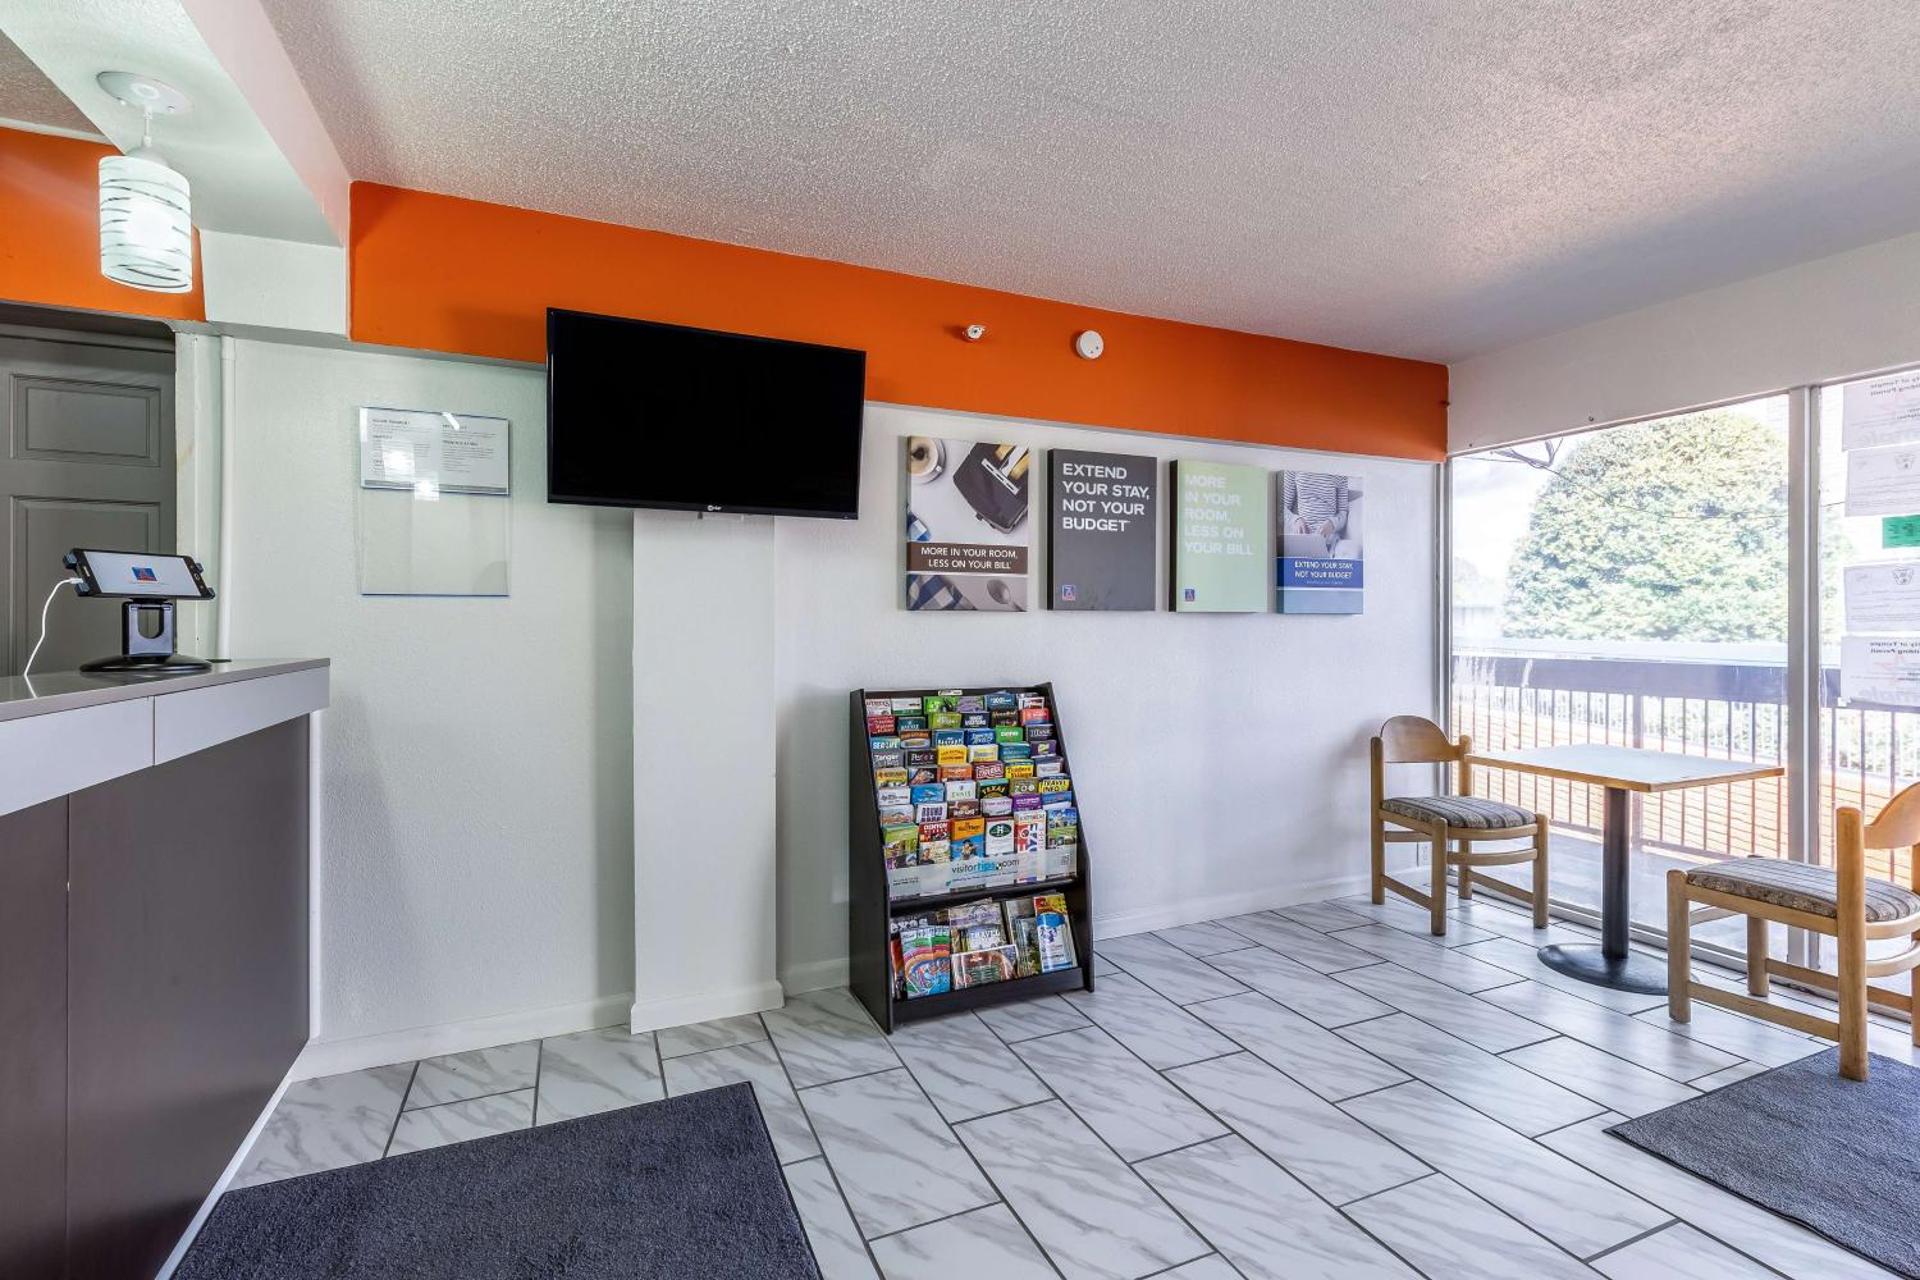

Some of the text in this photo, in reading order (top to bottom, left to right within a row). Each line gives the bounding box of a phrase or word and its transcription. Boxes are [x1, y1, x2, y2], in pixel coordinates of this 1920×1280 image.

[1063, 463, 1127, 480] EXTEND
[1184, 475, 1226, 488] MORE
[1062, 481, 1150, 500] YOUR STAY,
[1184, 491, 1241, 506] IN YOUR
[1062, 499, 1145, 515] NOT YOUR
[1062, 517, 1128, 532] BUDGET
[1184, 525, 1244, 539] LESS ON
[921, 547, 1018, 560] MORE IN YOUR ROOM,
[1184, 542, 1254, 555] YOUR BILL
[928, 559, 1012, 571] LESS ON YOUR BILL
[1294, 561, 1320, 569] EXTEND
[1321, 561, 1338, 570] YOUR
[1294, 570, 1354, 580] NOT YOUR BUDGET
[1014, 784, 1036, 793] ZOO
